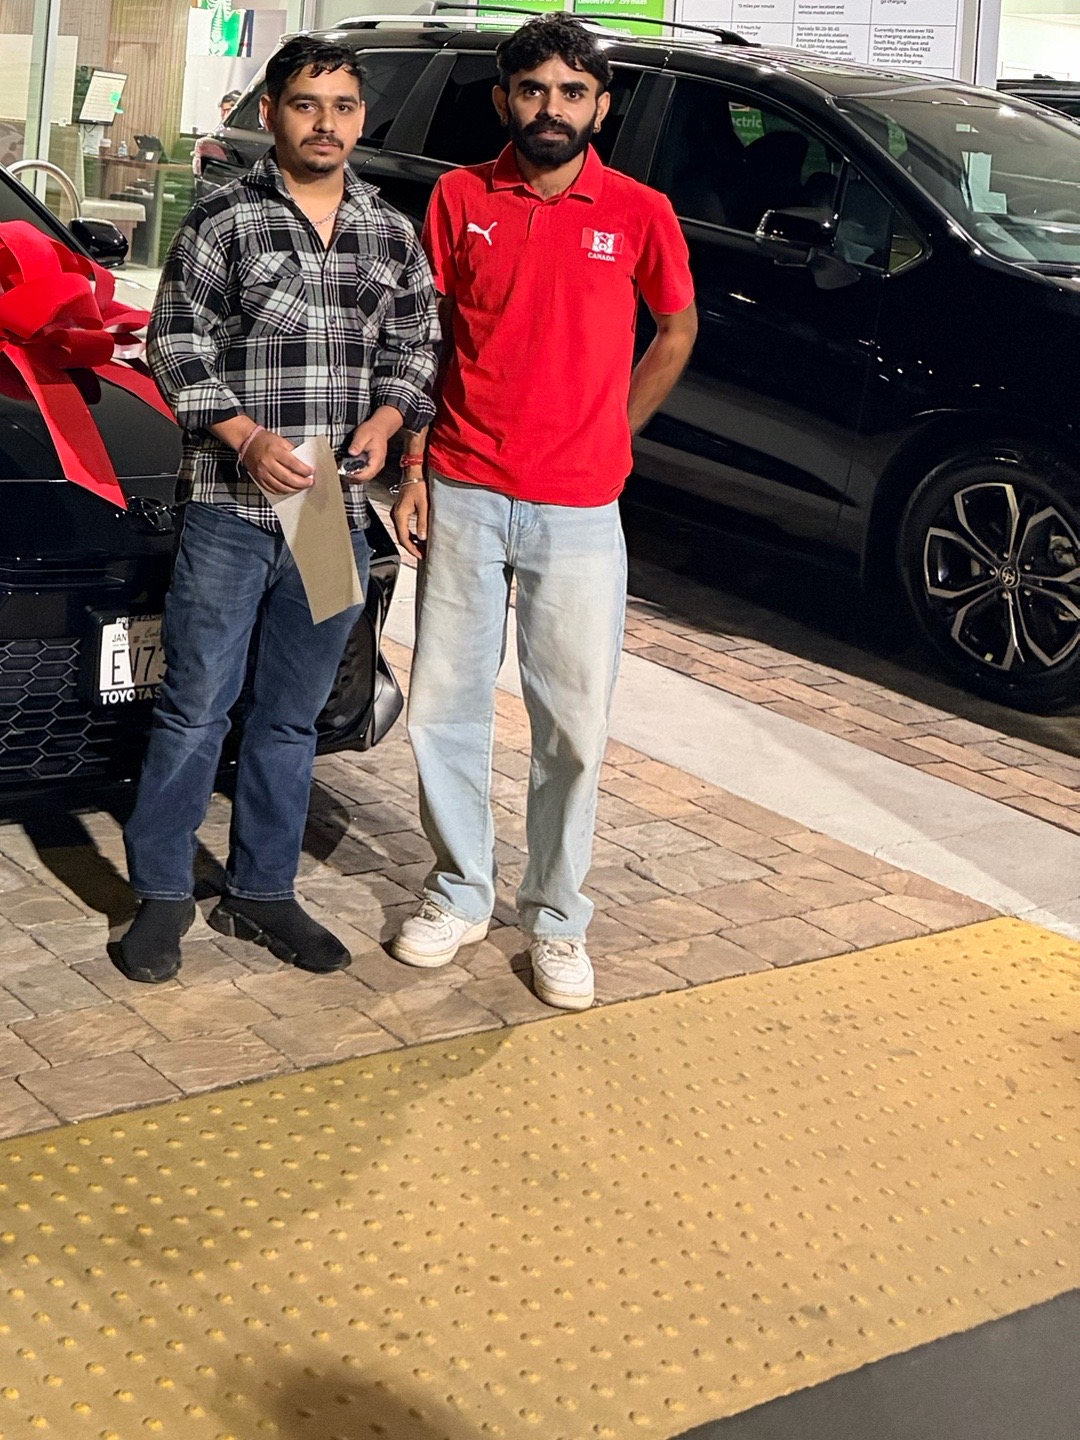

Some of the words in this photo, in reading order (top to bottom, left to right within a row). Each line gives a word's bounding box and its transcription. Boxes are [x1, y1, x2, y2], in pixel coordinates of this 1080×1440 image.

[587, 251, 616, 263] CANADA
[112, 634, 127, 642] JAN
[100, 688, 153, 705] TOYOTA
